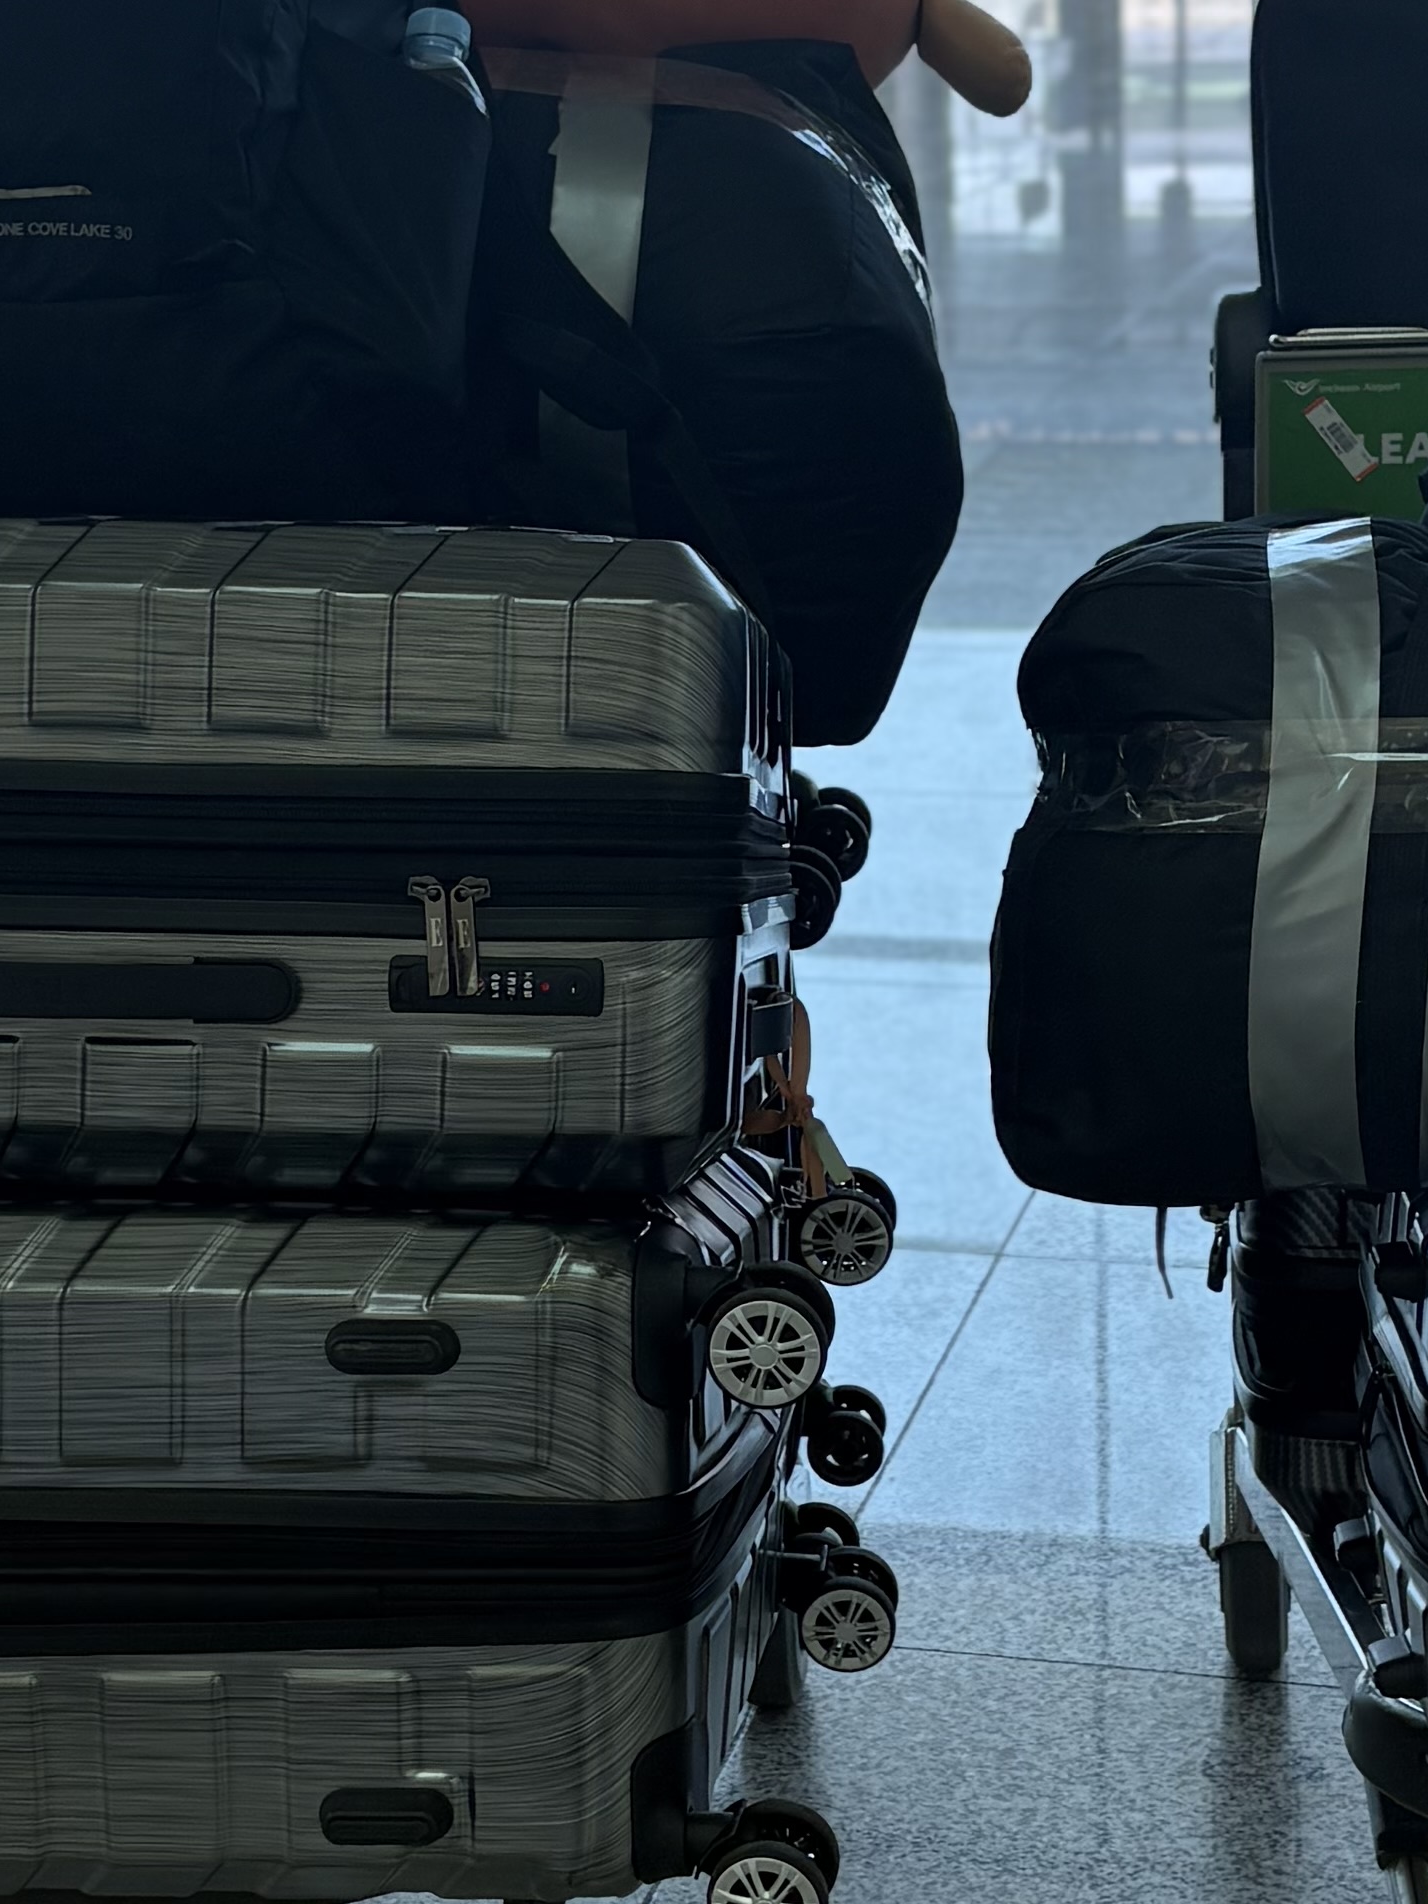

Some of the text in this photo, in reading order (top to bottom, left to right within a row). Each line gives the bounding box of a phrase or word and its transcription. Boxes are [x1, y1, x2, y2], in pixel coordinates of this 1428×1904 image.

[27, 222, 70, 237] COVE
[70, 223, 111, 238] LAKE
[113, 225, 133, 241] 30
[1363, 381, 1401, 394] Airport
[430, 917, 443, 947] E
[456, 919, 471, 948] E
